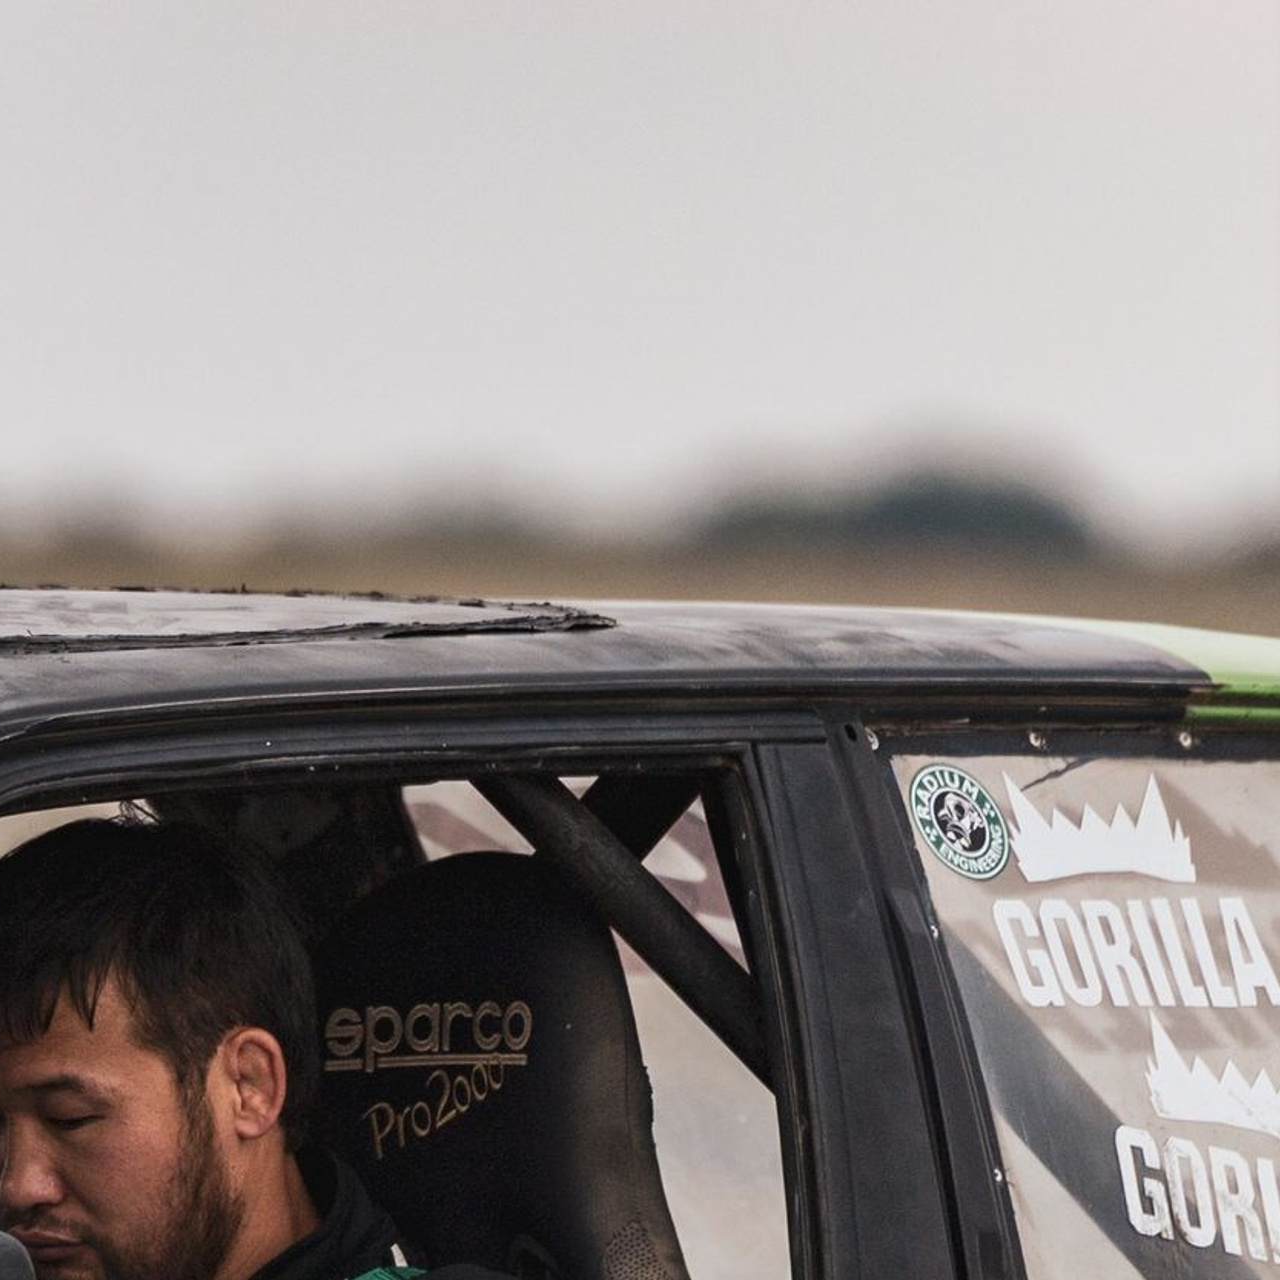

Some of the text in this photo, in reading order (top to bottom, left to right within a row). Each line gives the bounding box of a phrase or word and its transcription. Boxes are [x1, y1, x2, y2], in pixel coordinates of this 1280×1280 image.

[916, 769, 980, 820] RADIUM
[992, 898, 1280, 1008] GORILLA
[325, 1001, 532, 1073] sparco
